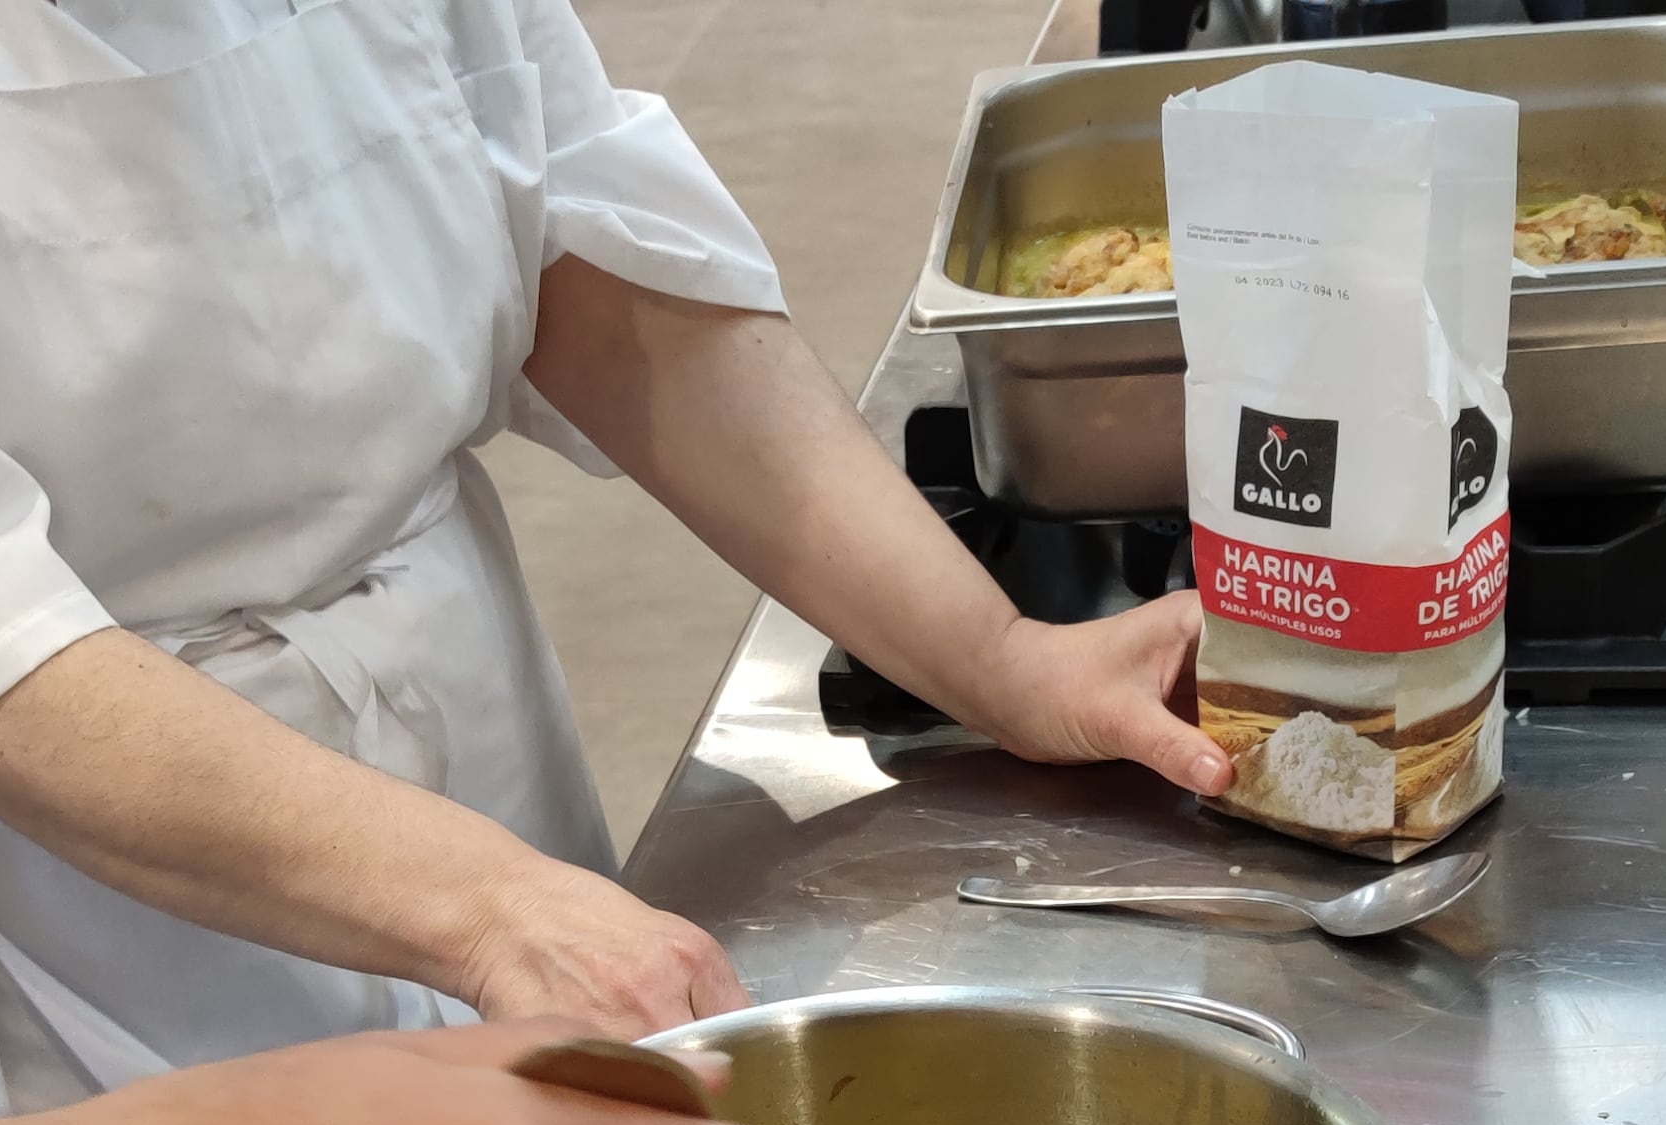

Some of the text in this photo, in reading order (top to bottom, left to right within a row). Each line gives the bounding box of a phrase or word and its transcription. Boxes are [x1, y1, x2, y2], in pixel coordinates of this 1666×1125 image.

[1254, 276, 1284, 288] 2023
[1313, 283, 1332, 298] 094
[1241, 482, 1322, 513] GALLO
[1224, 543, 1337, 591] HARINA
[1434, 530, 1506, 595] HARINA
[1215, 567, 1351, 622] DE TRIGO
[1418, 593, 1460, 626] DE
[1220, 599, 1342, 640] PARA MÚLTIPLES USOS
[1423, 625, 1456, 641] PARA
